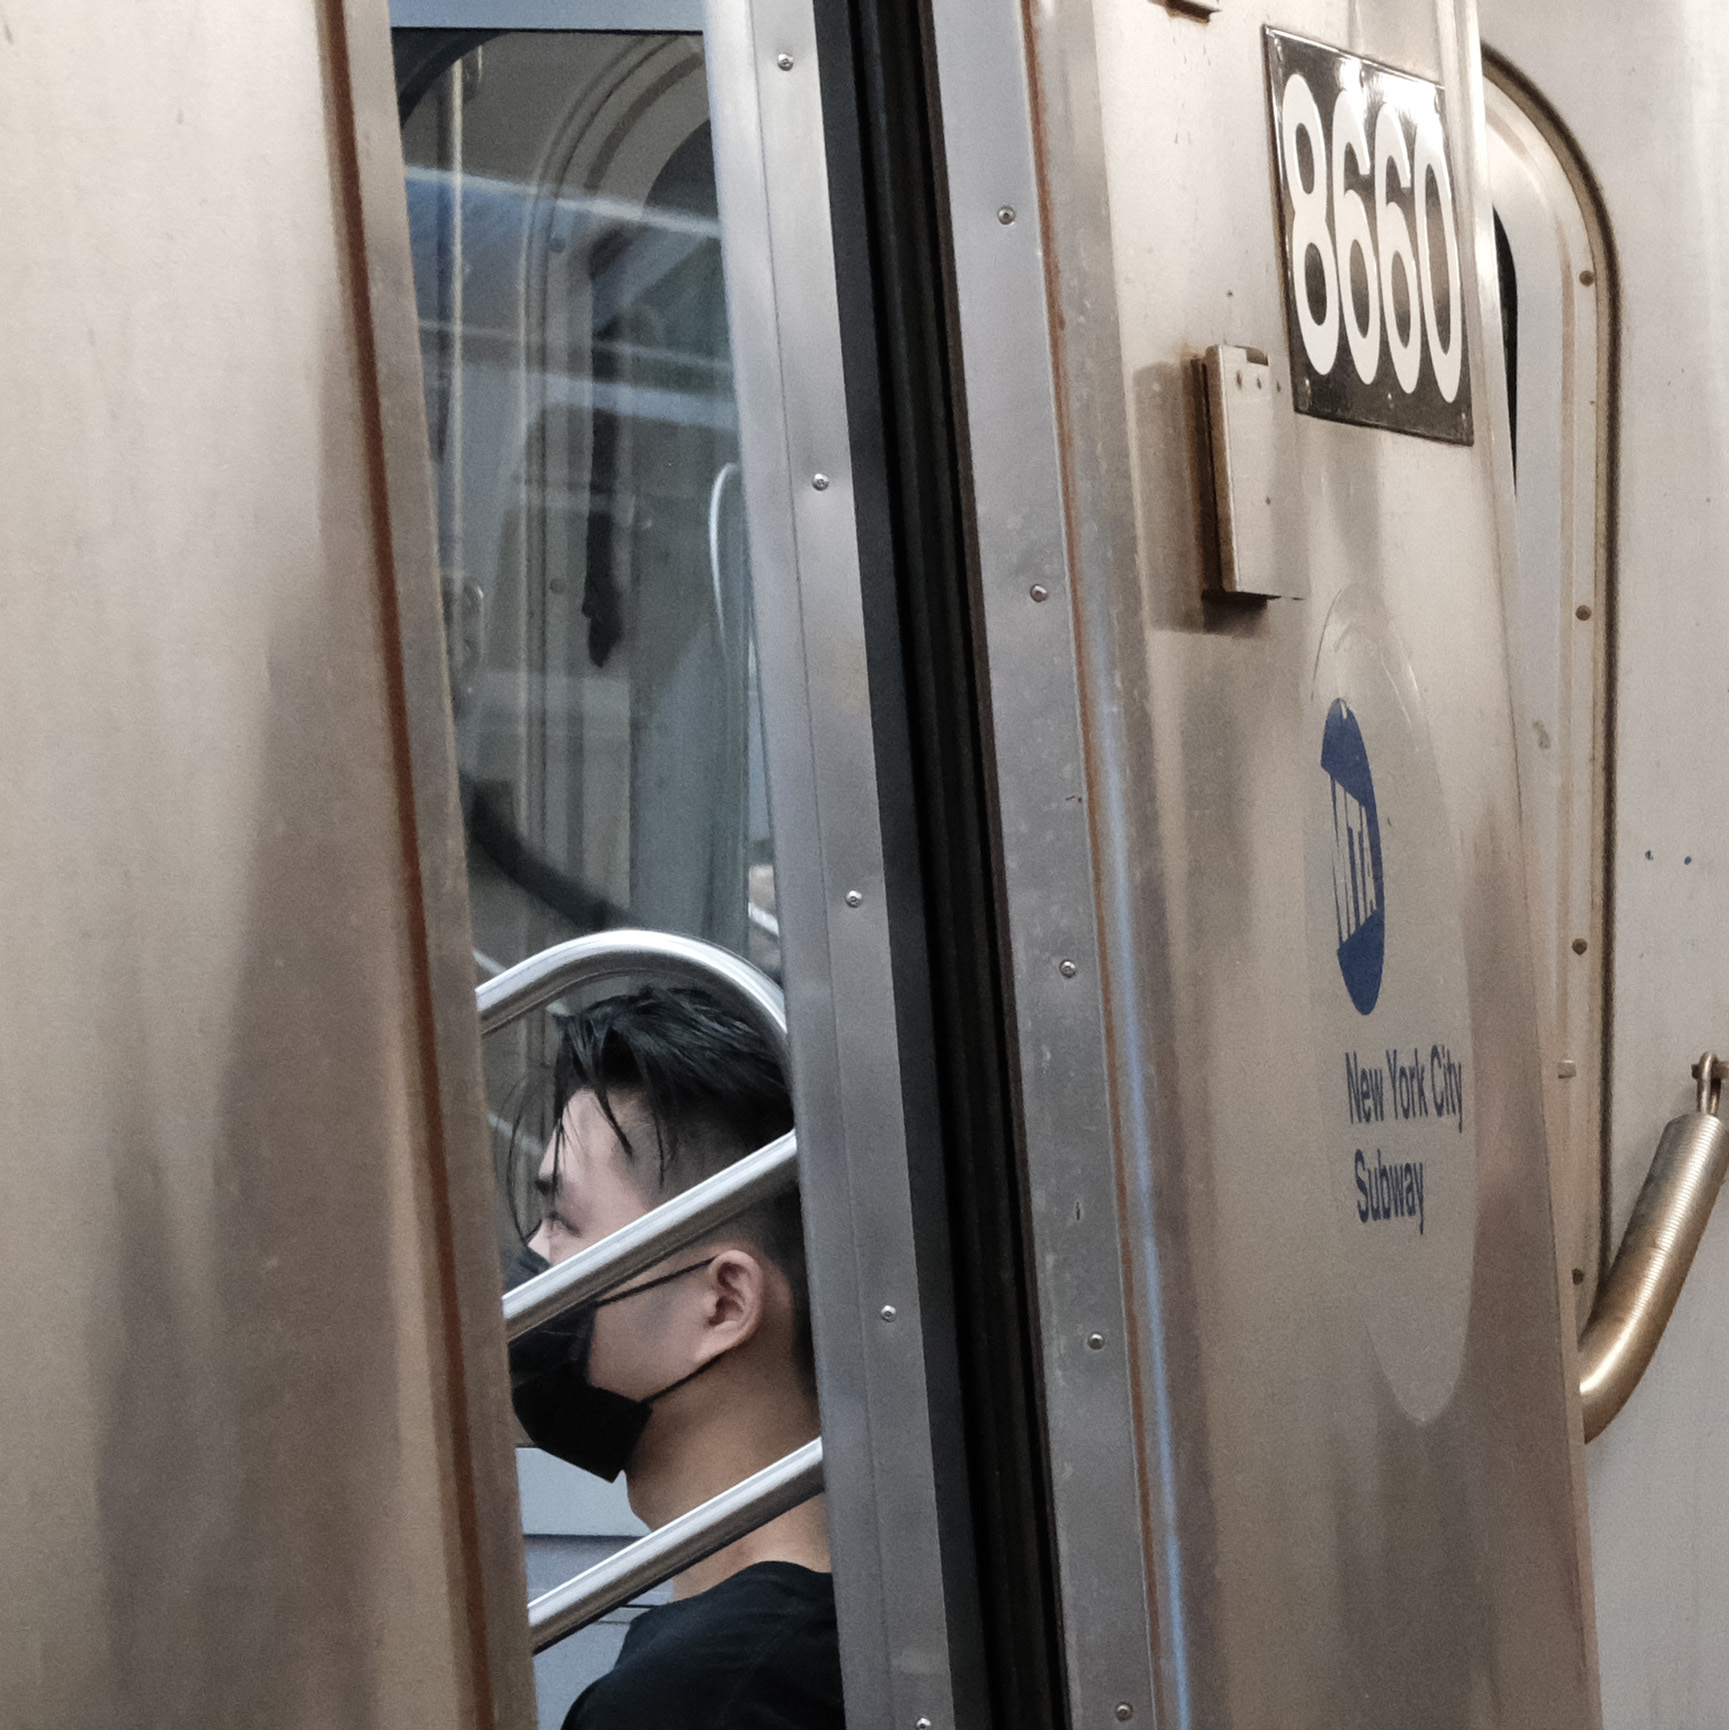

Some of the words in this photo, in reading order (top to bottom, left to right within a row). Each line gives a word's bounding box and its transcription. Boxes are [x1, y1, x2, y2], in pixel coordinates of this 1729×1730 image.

[1282, 74, 1462, 404] 8660
[1345, 1051, 1384, 1125] New
[1385, 1047, 1429, 1120] York
[1430, 1044, 1463, 1134] City
[1354, 1148, 1425, 1236] Subway
